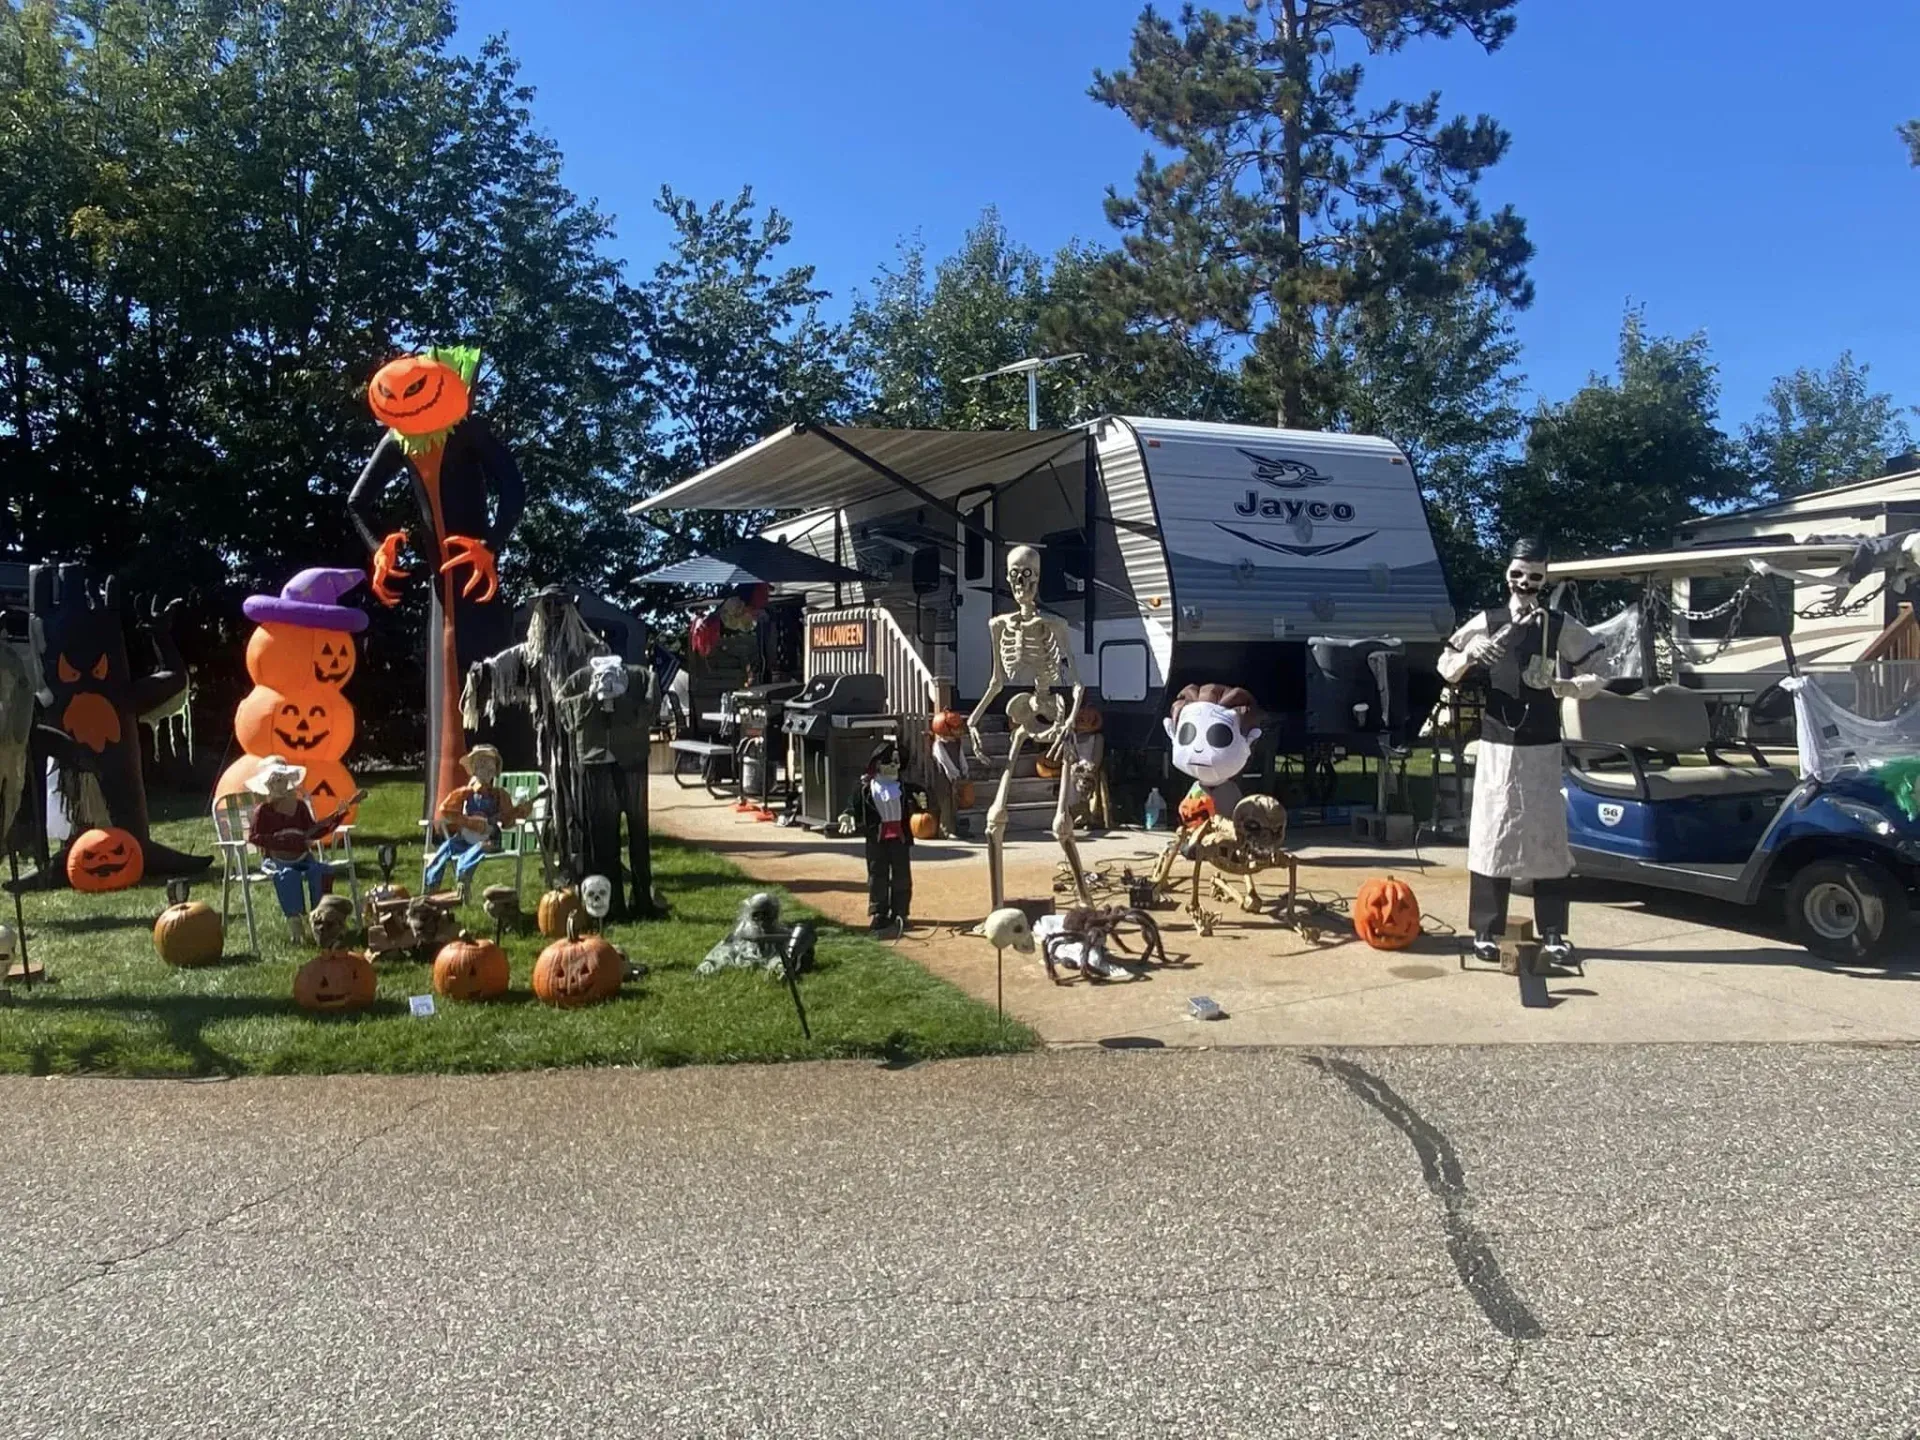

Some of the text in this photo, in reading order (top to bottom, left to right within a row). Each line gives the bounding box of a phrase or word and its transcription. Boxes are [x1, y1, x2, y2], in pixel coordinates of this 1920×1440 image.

[1234, 490, 1355, 523] Jayco
[813, 623, 863, 647] HALLOWEEN
[1603, 807, 1619, 817] 56
